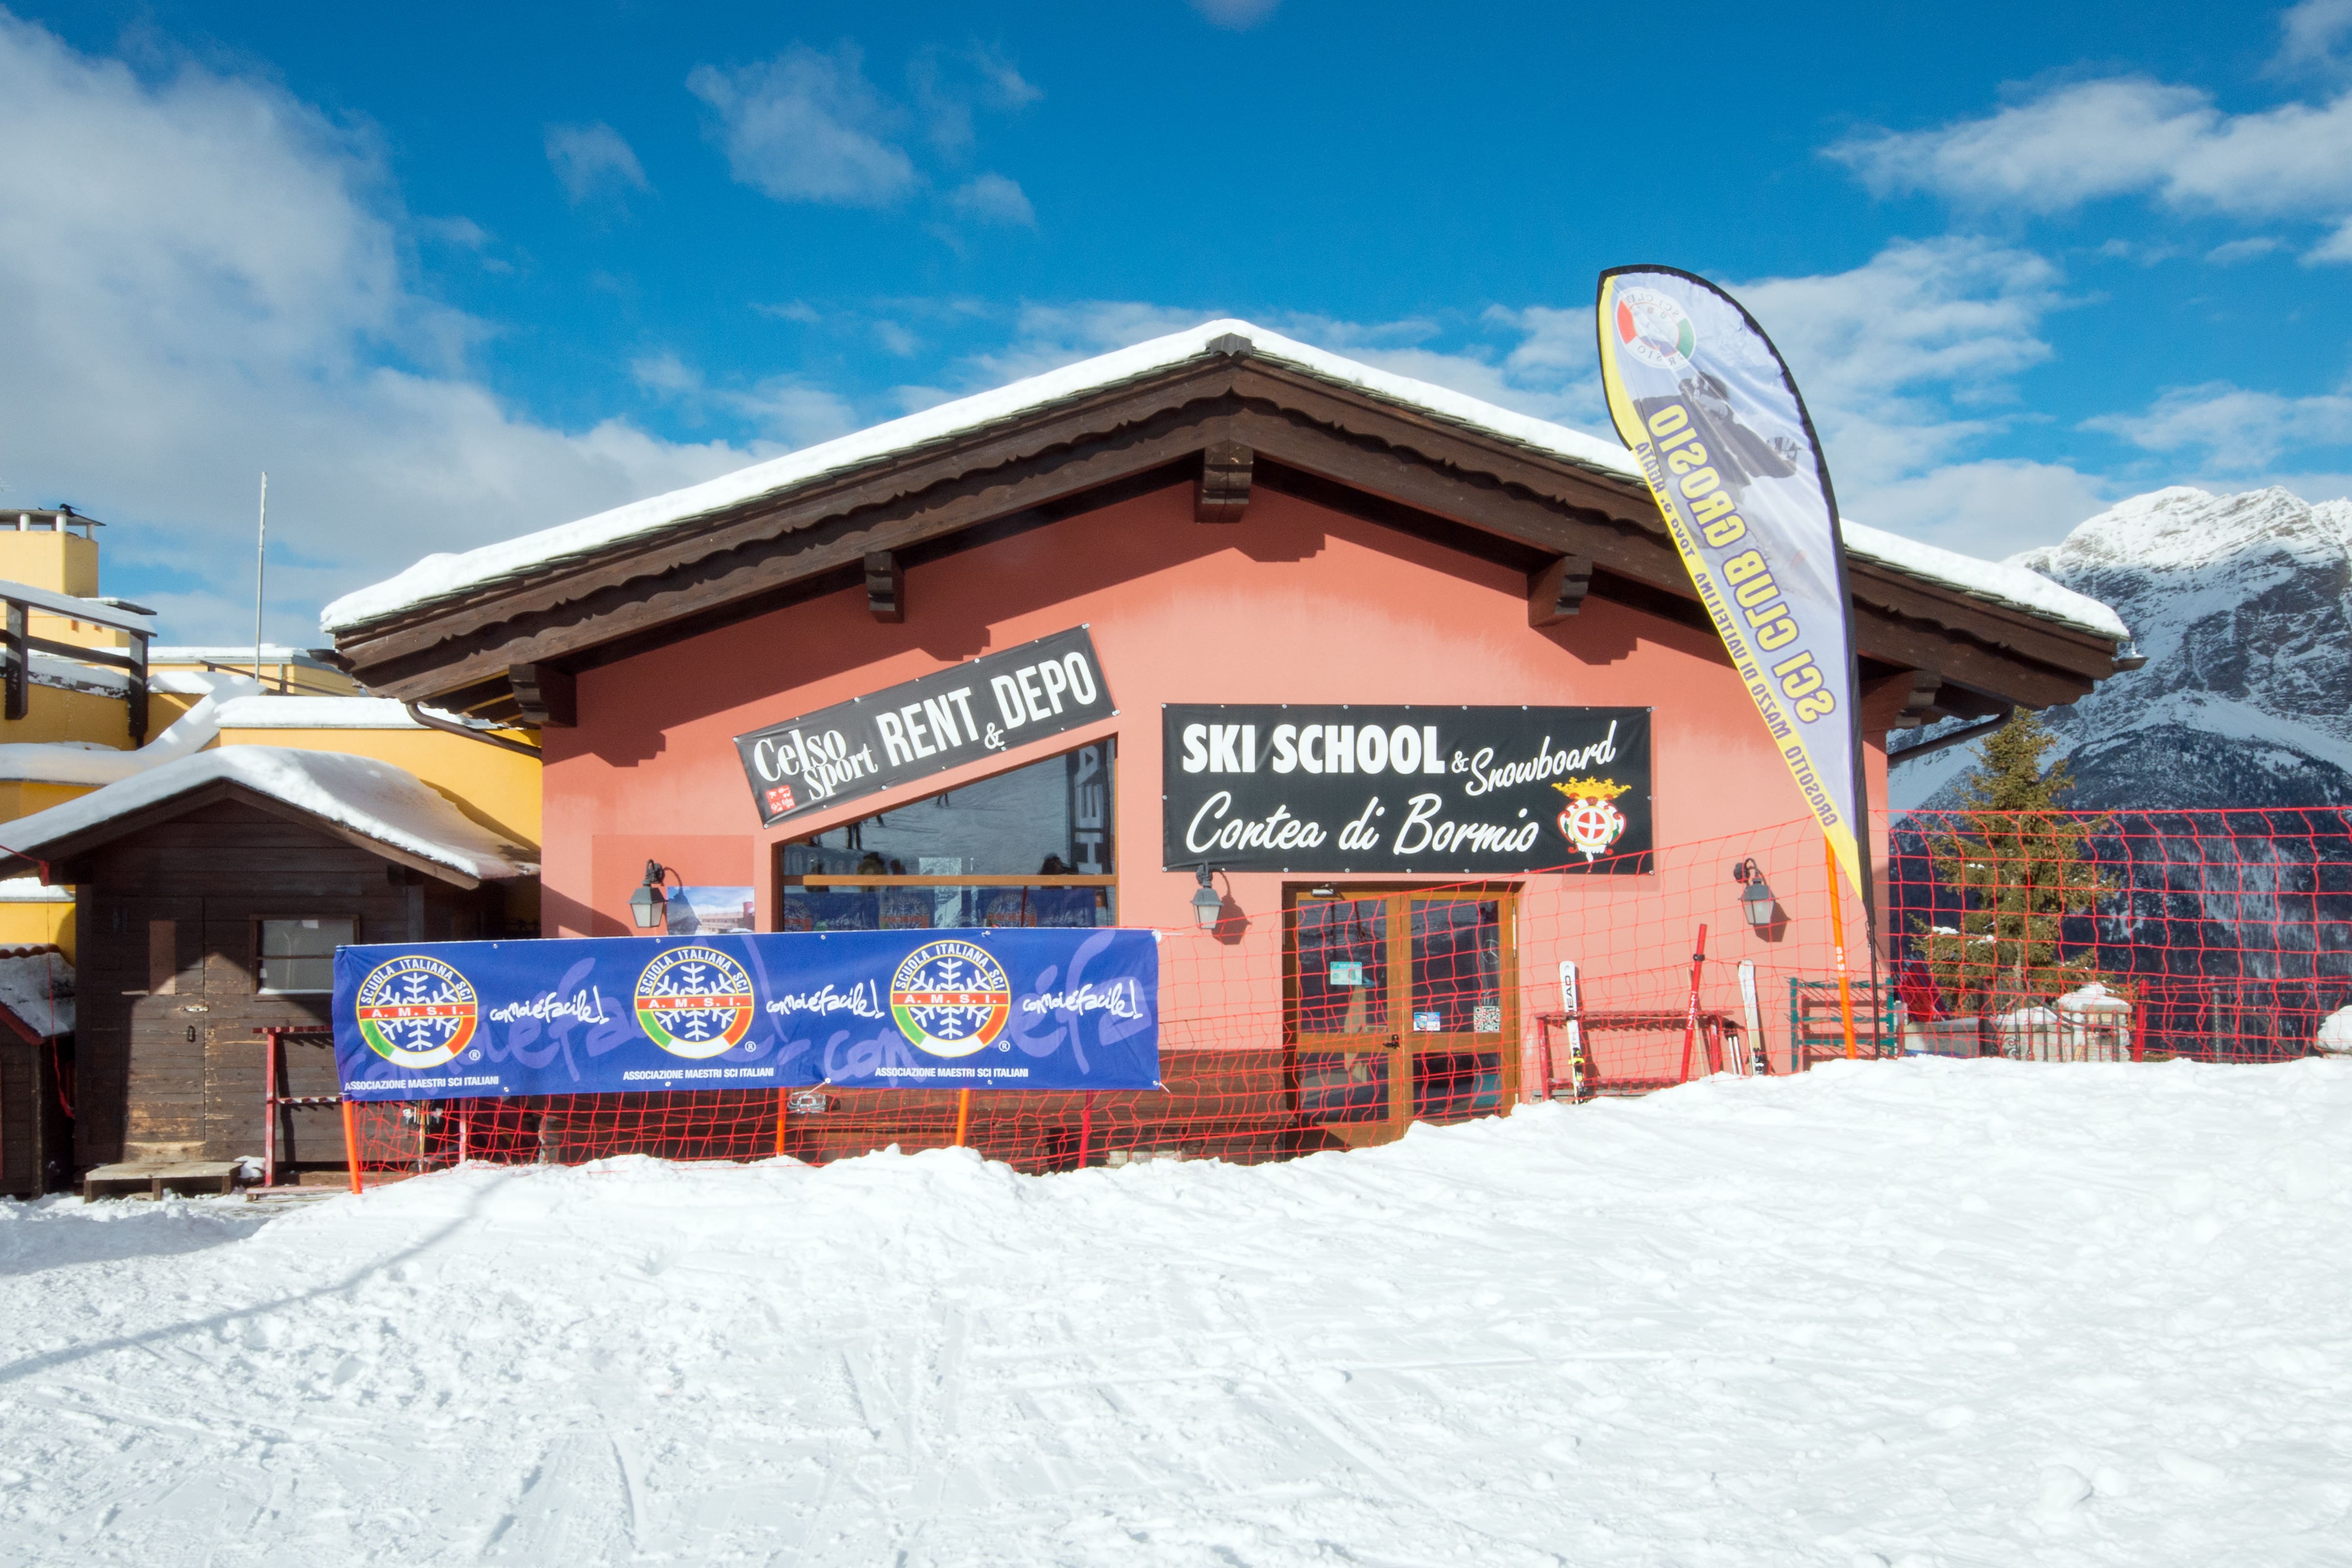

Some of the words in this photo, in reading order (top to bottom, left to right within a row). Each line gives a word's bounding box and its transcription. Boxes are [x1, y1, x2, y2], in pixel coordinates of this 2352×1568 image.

[990, 651, 1097, 731] DEPO
[876, 686, 980, 767] RENT
[984, 723, 1004, 749] &
[754, 729, 847, 782] Celso
[1182, 723, 1255, 774] SKI
[1273, 723, 1445, 774] SCHOOL
[1451, 751, 1469, 772] &
[1466, 720, 1617, 796] Snowboard
[1185, 791, 1327, 853] Contea
[1339, 796, 1385, 851] di
[1393, 793, 1540, 855] Bormio
[361, 966, 395, 1004] SCUOLA
[400, 959, 453, 980] ITALIANA
[456, 981, 472, 1001] SCI
[639, 956, 673, 994] SCUOLA
[678, 949, 733, 971] ITALIANA
[733, 972, 749, 992] SCI
[896, 950, 930, 990] SCUOLA
[936, 944, 989, 967] ITALIANA
[989, 969, 1004, 990] SCI
[344, 1080, 406, 1091] ASSOCIAZIONE
[408, 1079, 446, 1089] MAESTRI
[448, 1078, 463, 1087] SCI
[464, 1076, 499, 1086] ITALIANI
[623, 1070, 683, 1080] ASSOCIAZIONE
[685, 1069, 722, 1079] MAESTRI
[724, 1068, 738, 1078] SCI
[739, 1068, 774, 1078] ITALIANI
[875, 1067, 935, 1078] ASSOCIAZIONE
[937, 1068, 976, 1078] MAESTRI
[977, 1068, 991, 1078] SCI
[993, 1068, 1029, 1078] ITALIANI
